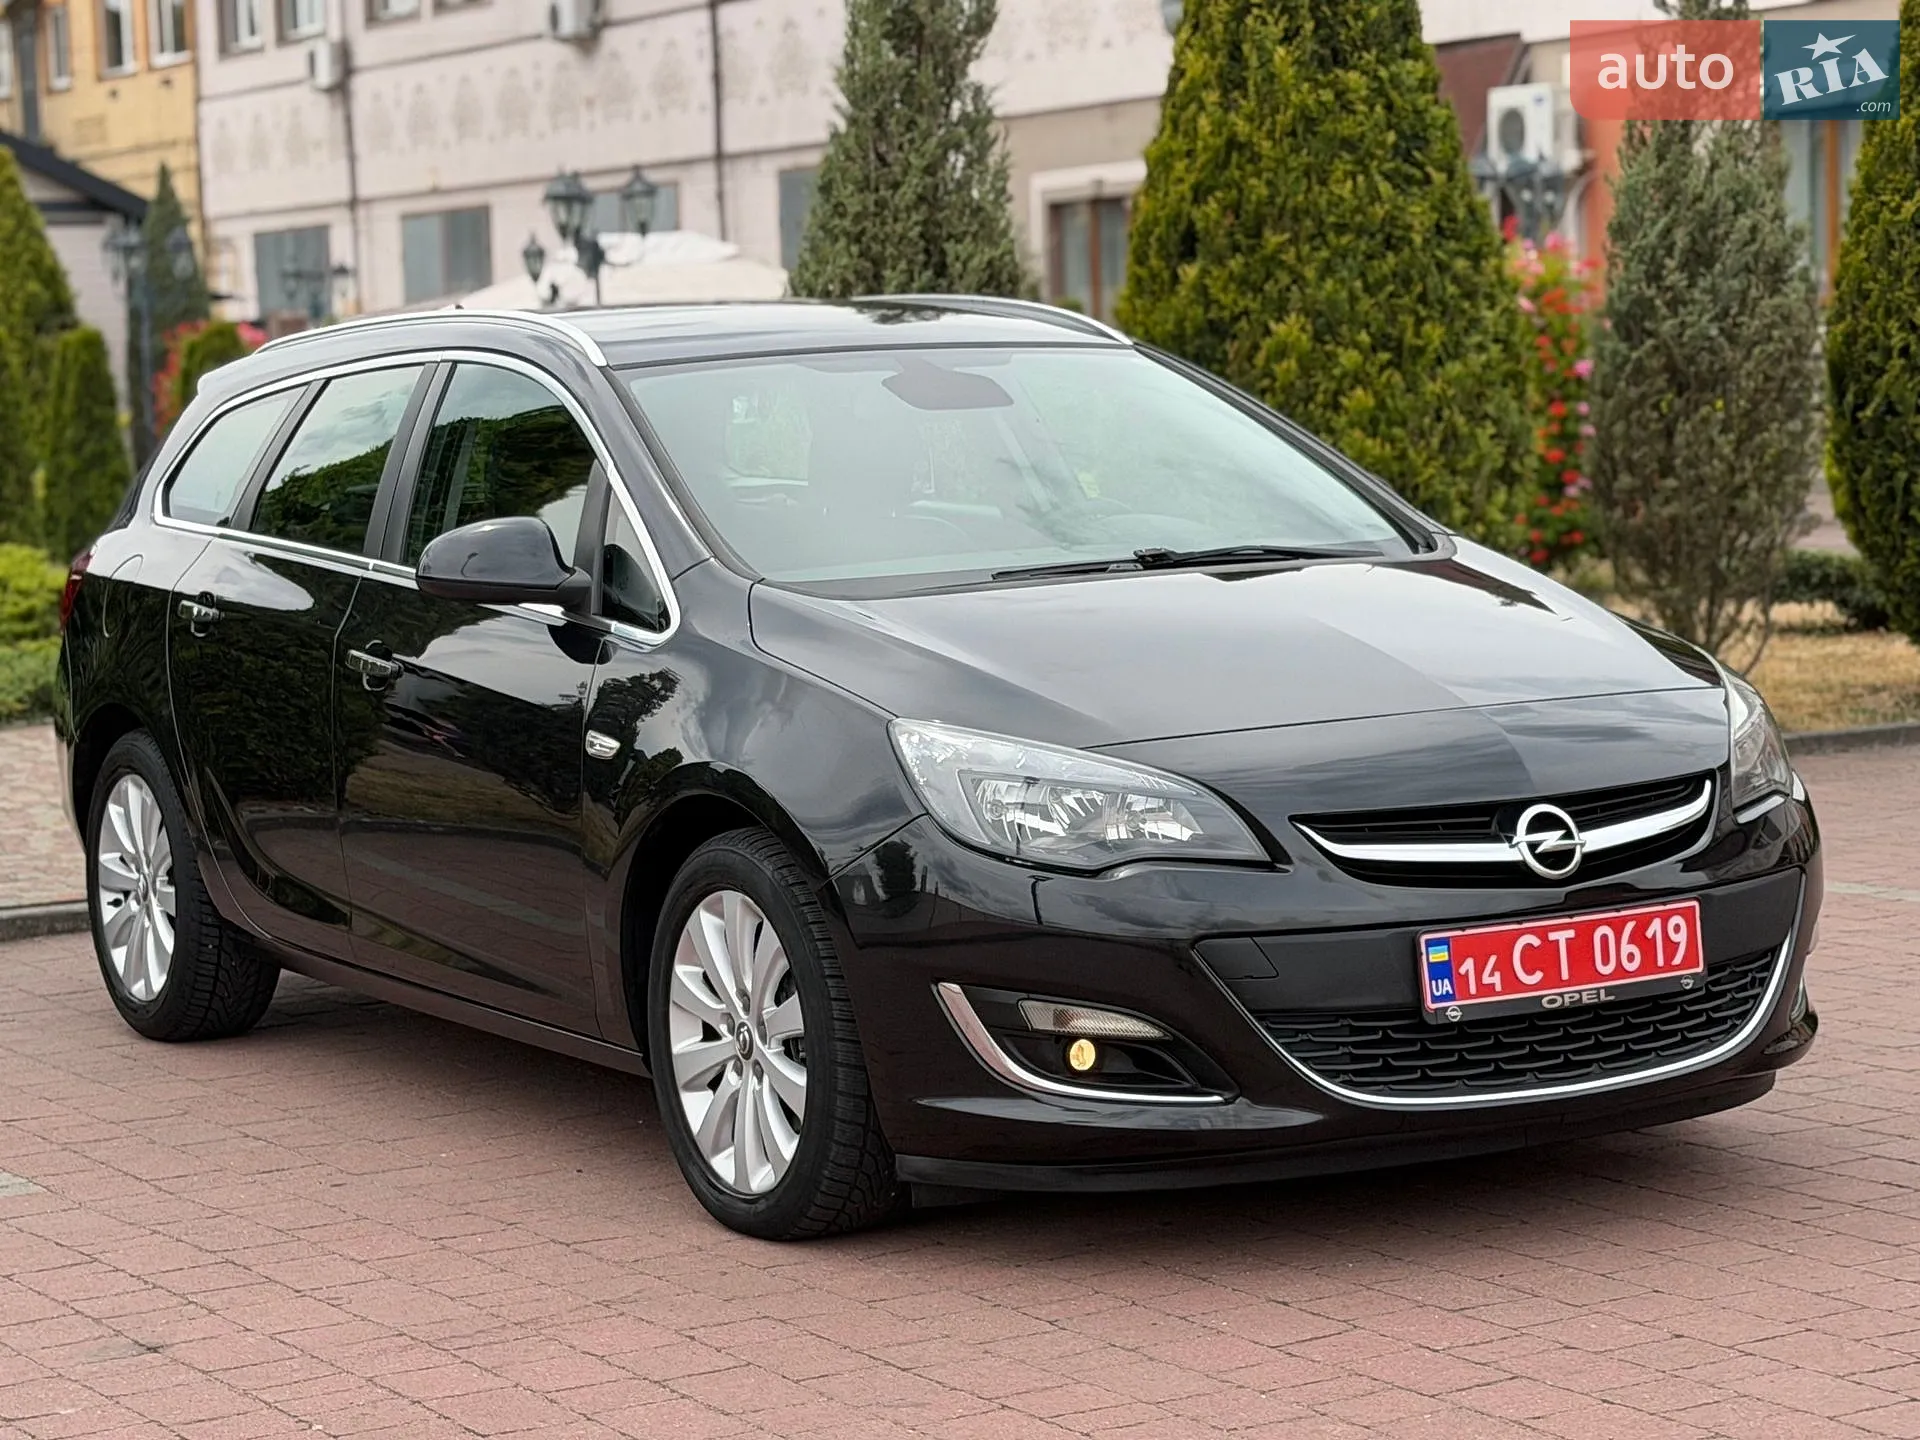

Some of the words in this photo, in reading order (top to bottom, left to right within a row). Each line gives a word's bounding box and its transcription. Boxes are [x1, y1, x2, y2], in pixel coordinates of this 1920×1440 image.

[1458, 954, 1502, 995] 14
[1512, 929, 1575, 985] CT
[1593, 914, 1688, 976] 0619
[1432, 979, 1453, 996] UA
[1541, 988, 1615, 1009] OPEL
